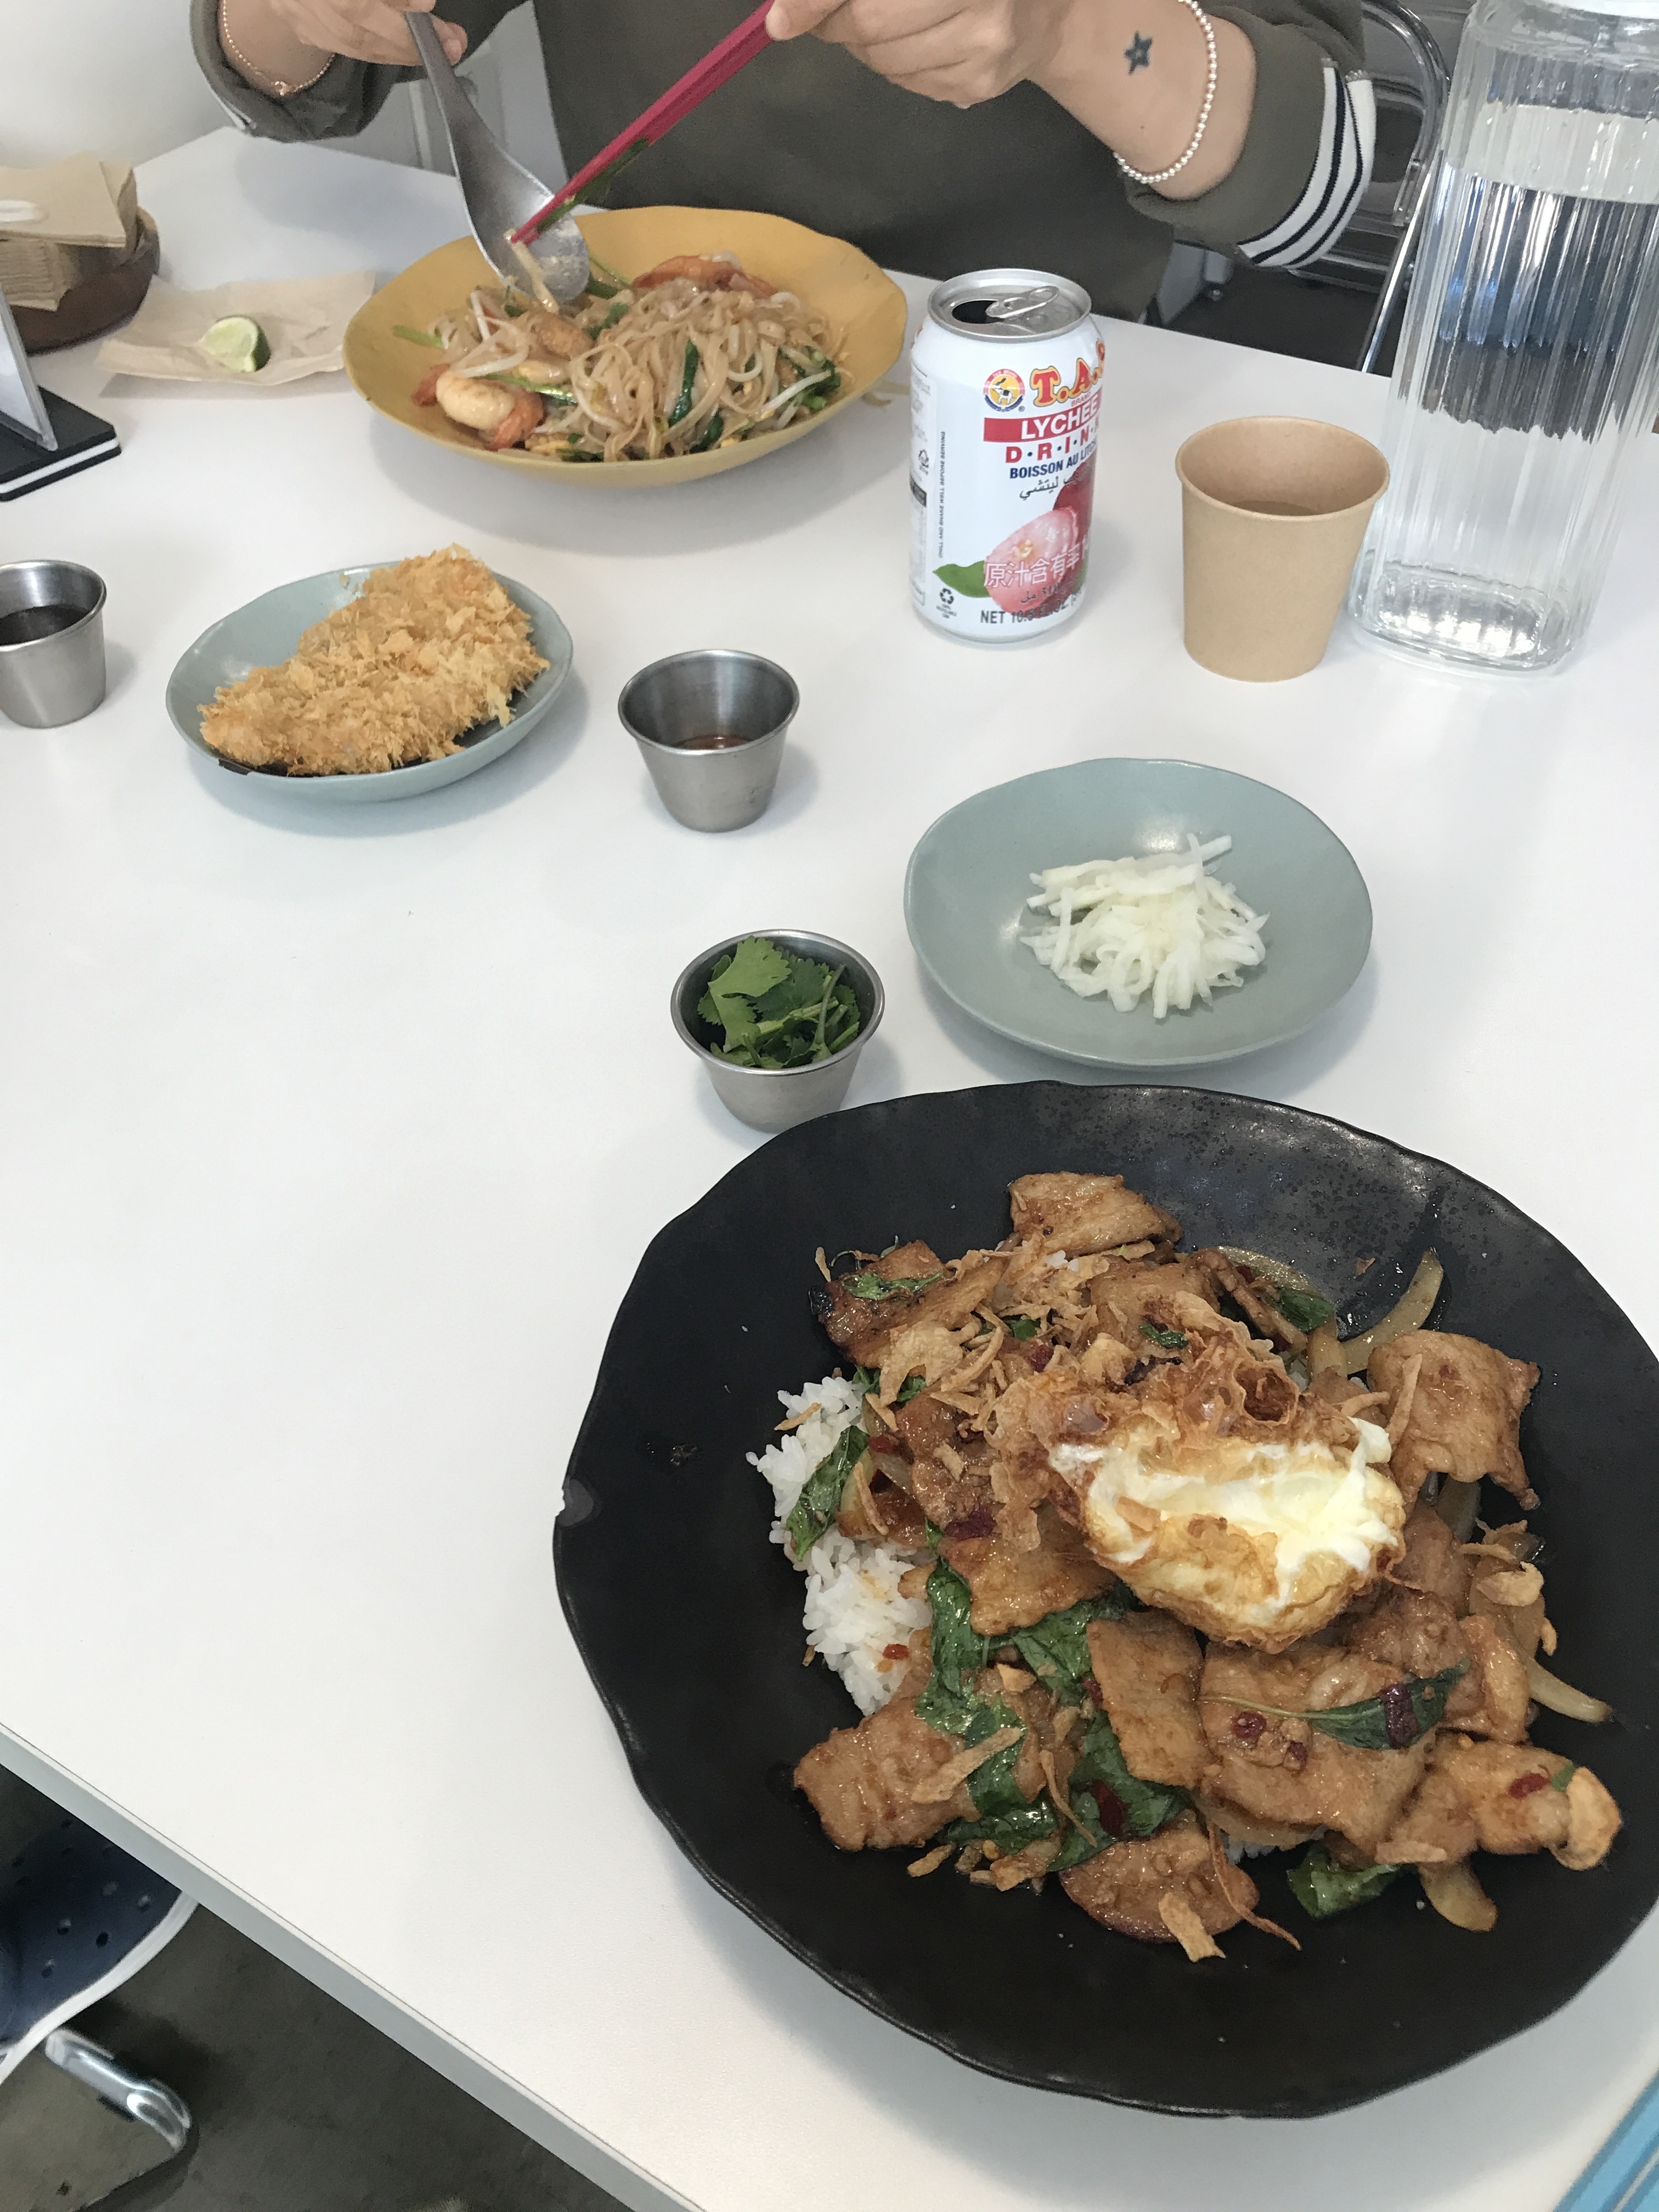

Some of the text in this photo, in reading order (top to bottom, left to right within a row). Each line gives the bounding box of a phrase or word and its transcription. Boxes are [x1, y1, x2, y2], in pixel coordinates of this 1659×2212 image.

[1021, 393, 1098, 440] LYCHEE
[1009, 459, 1063, 479] BOISSON
[1066, 452, 1079, 468] AU
[980, 610, 1006, 624] NET
